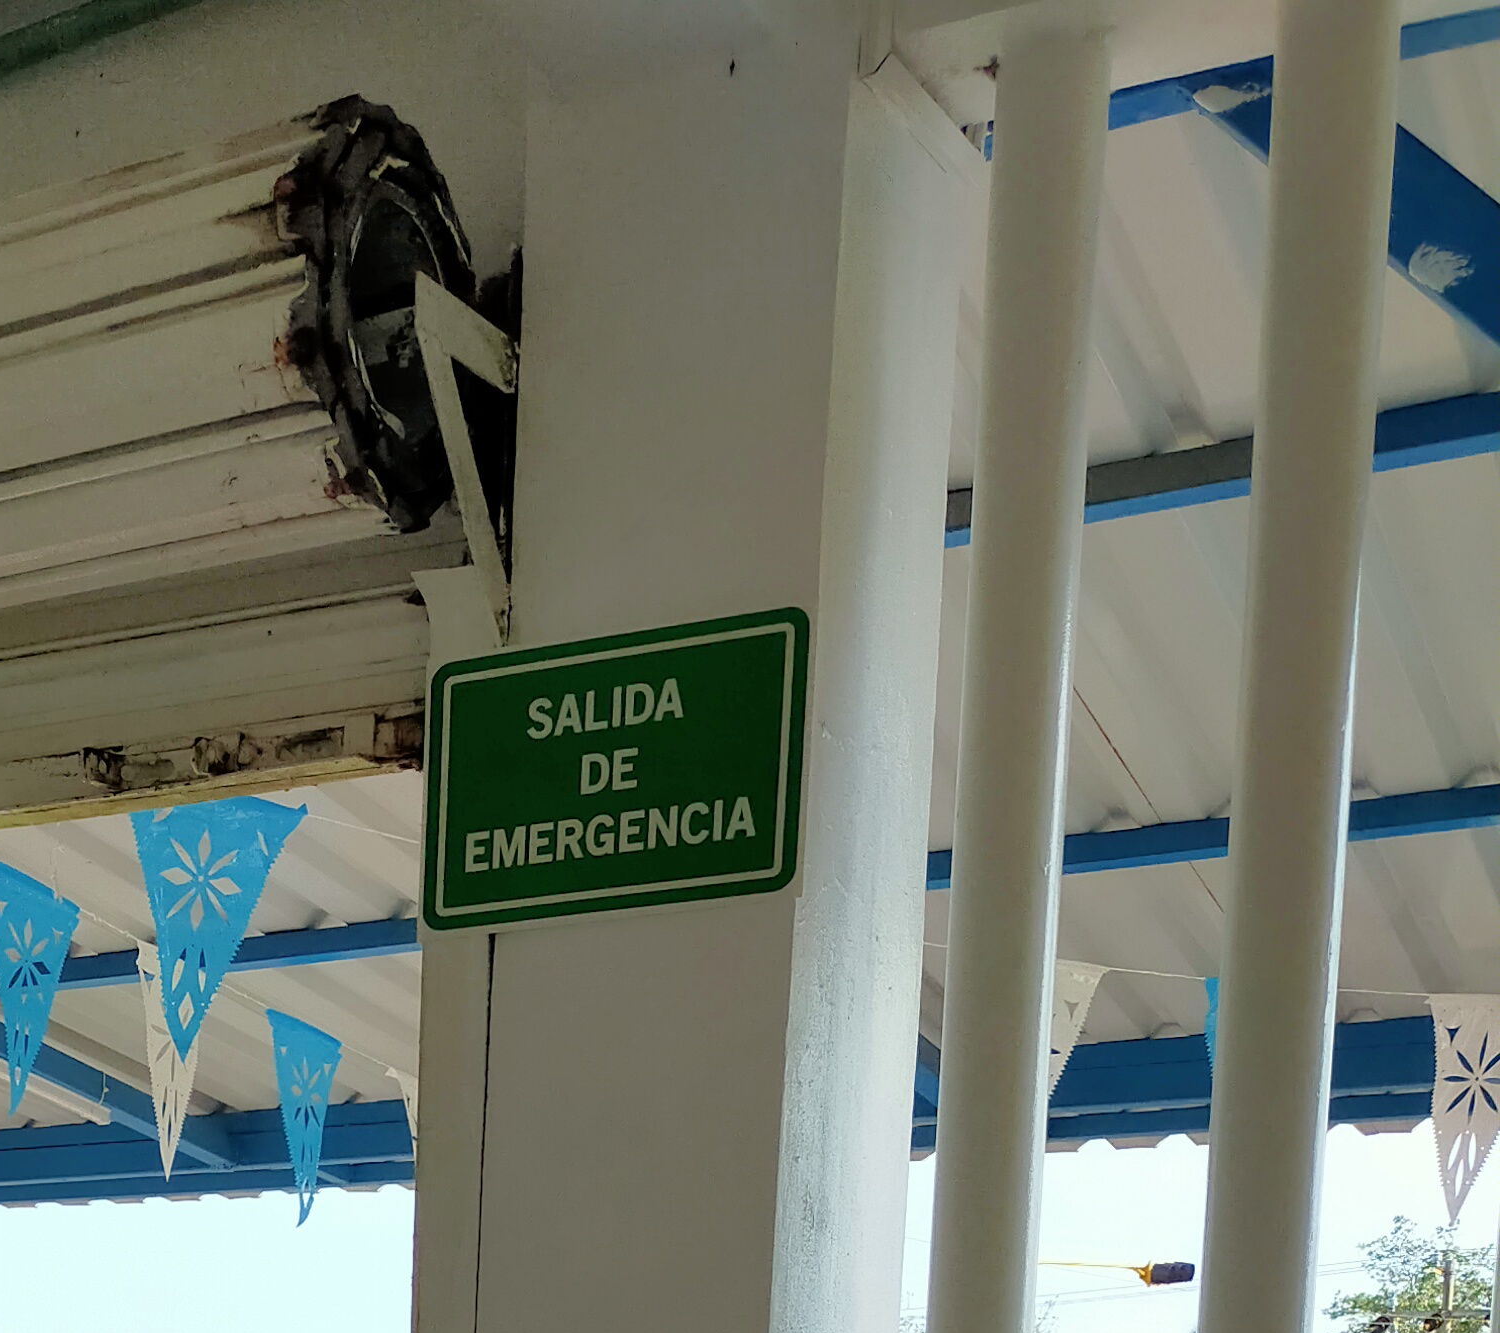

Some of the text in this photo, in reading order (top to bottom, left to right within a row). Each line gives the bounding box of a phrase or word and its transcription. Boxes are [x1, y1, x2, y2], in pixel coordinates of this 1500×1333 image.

[527, 678, 684, 740] SALIDA
[580, 747, 639, 795] DE
[465, 796, 756, 873] EMERGENCIA
